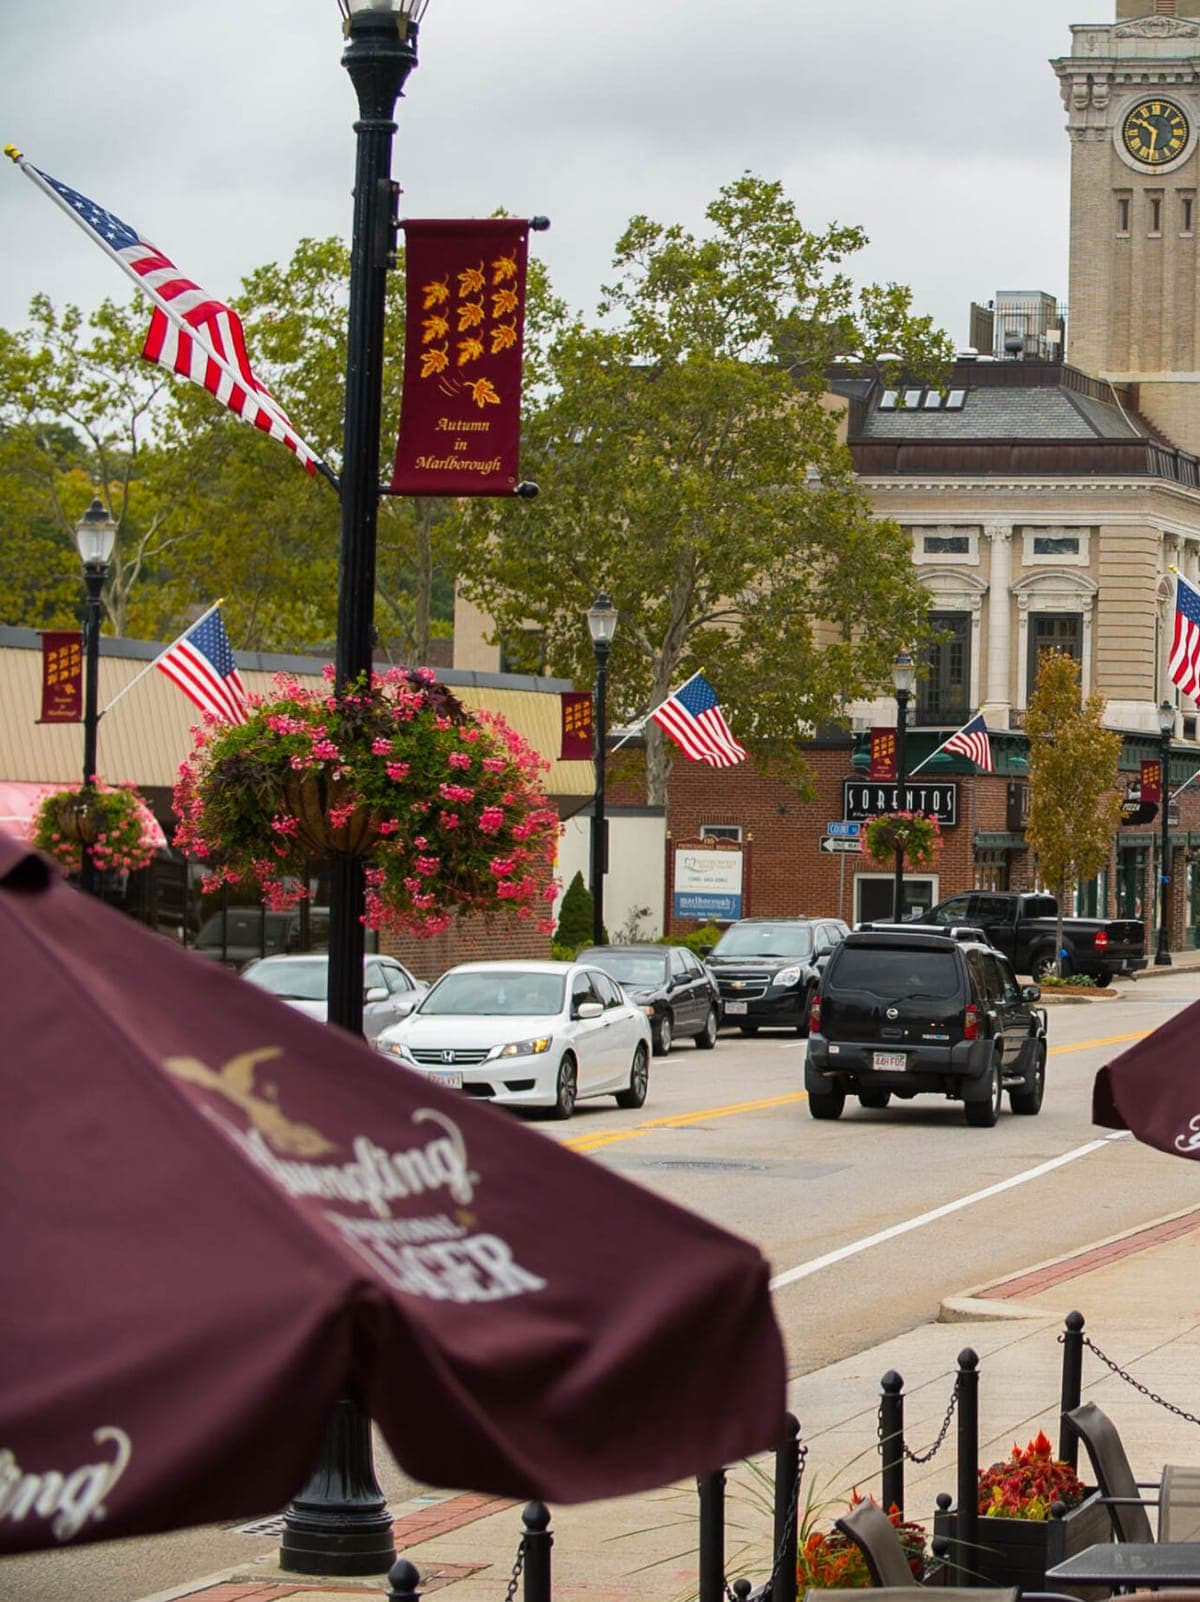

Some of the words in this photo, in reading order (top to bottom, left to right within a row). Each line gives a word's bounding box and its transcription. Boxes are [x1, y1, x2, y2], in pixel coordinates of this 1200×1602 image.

[434, 417, 491, 432] Autumn
[453, 437, 469, 451] in
[414, 455, 503, 476] Marlborough
[848, 788, 953, 811] SORENTOS
